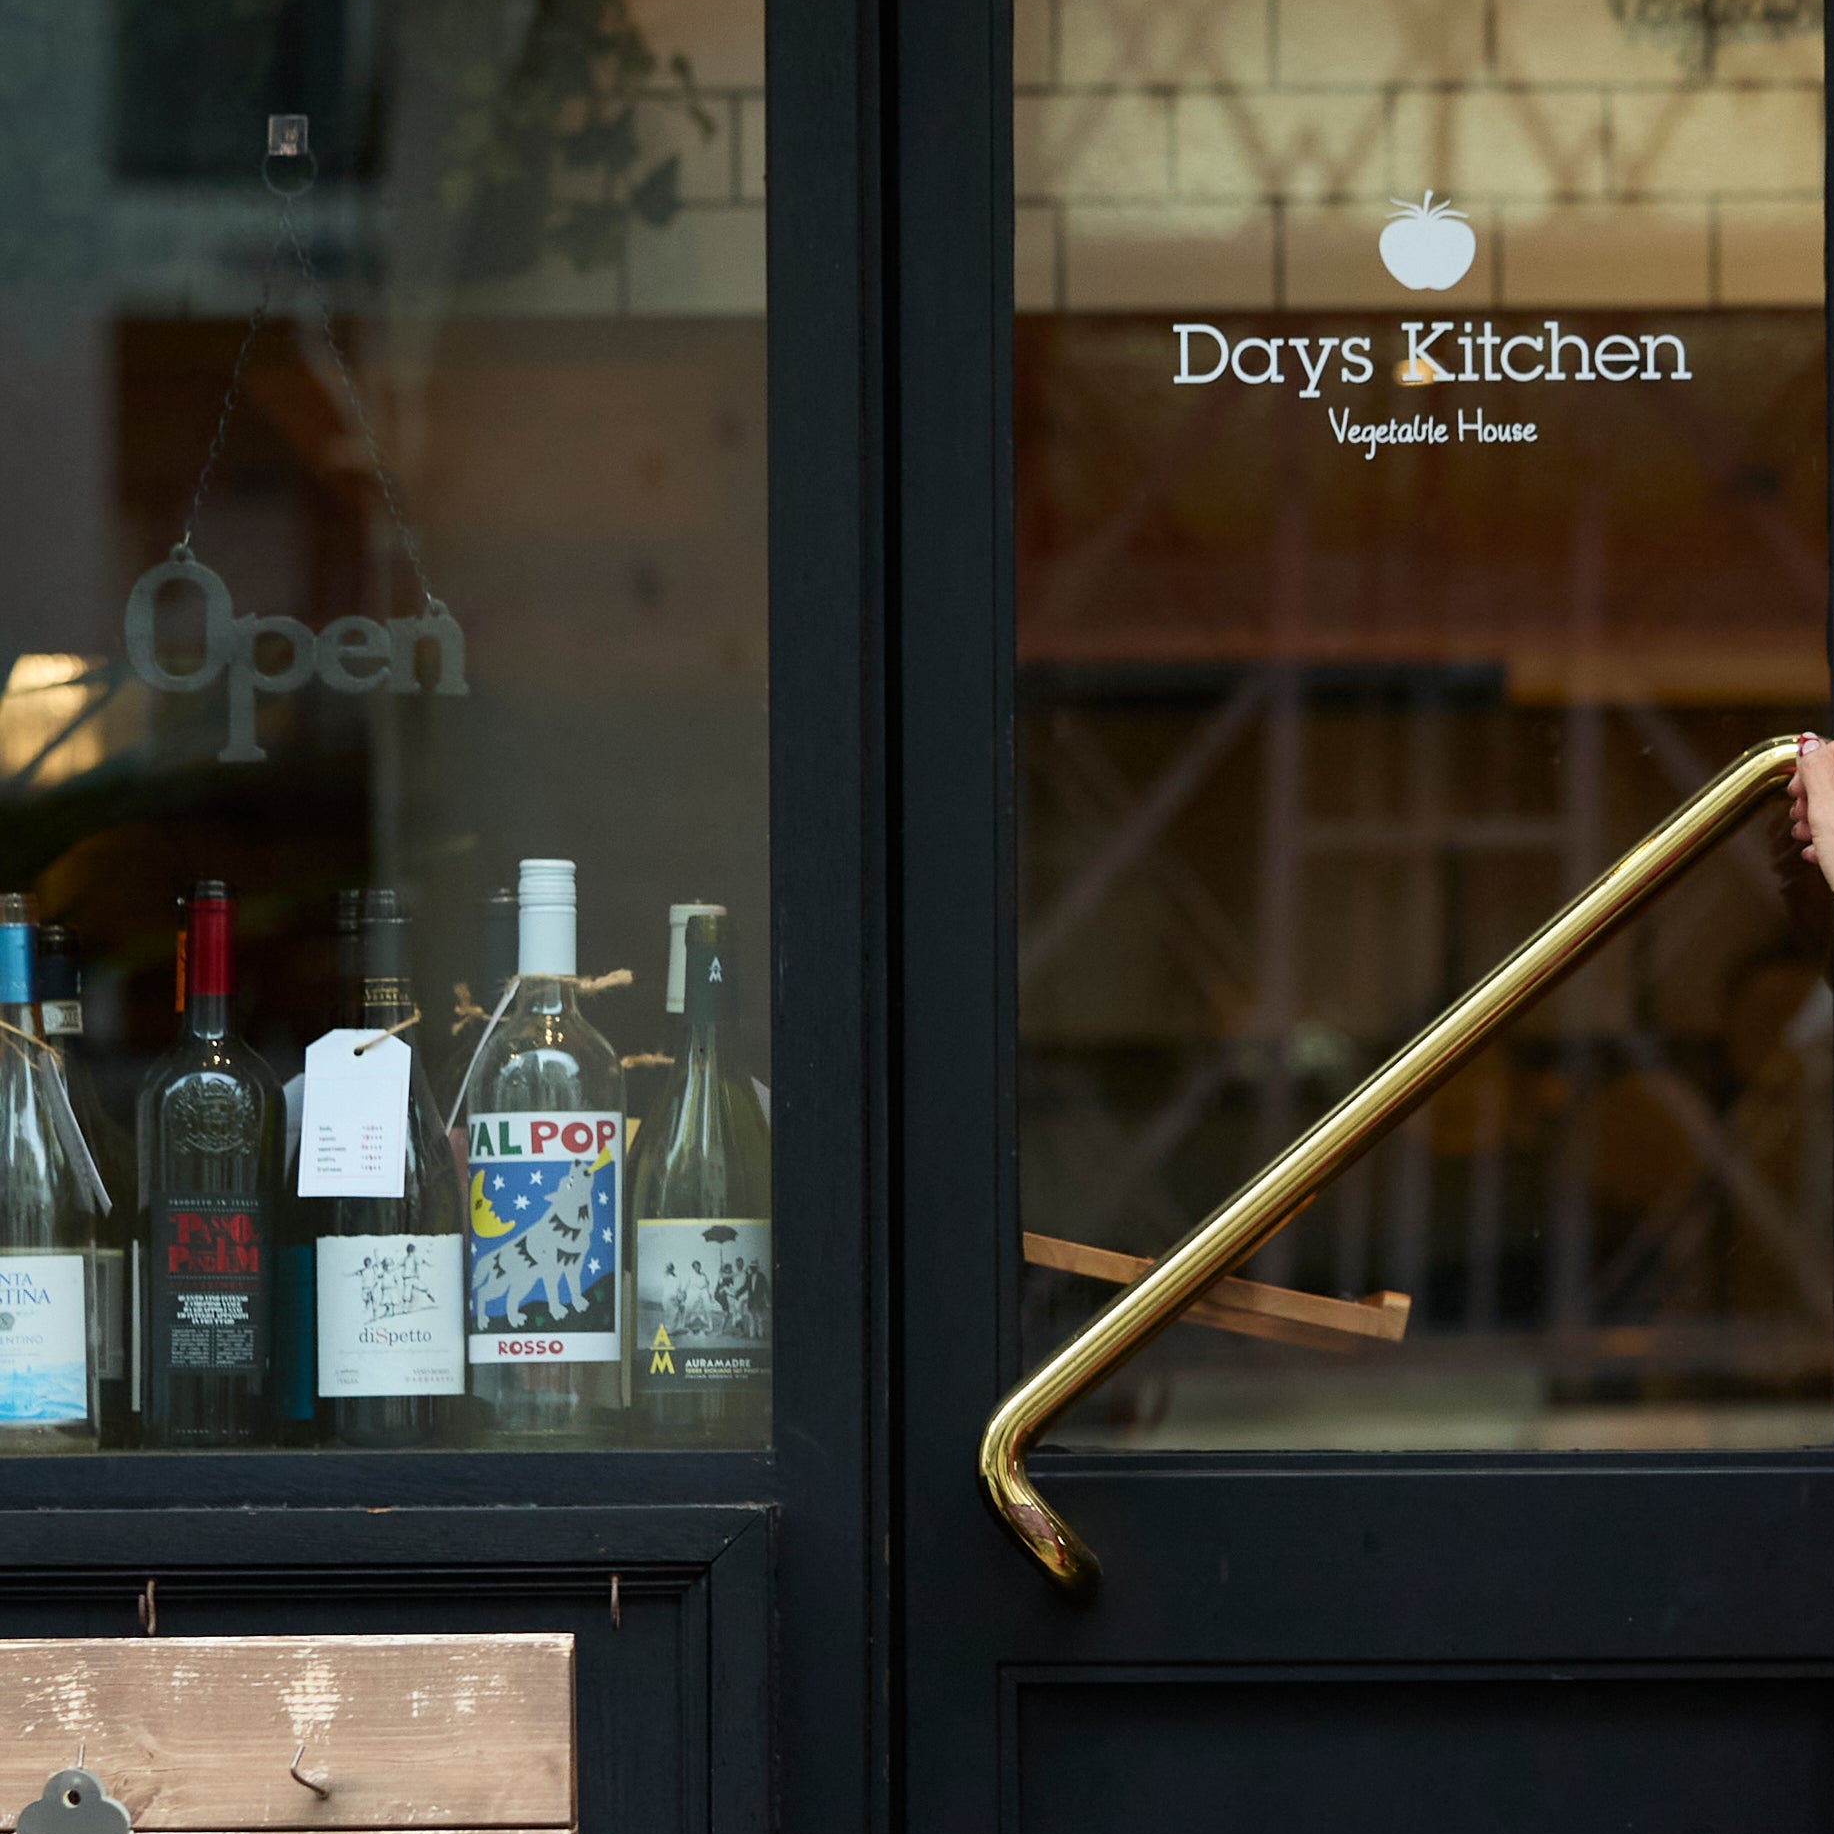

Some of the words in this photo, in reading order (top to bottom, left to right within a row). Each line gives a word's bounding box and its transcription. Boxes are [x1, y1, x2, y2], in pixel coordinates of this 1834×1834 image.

[1172, 322, 1374, 399] Days
[1400, 320, 1693, 383] Kitchen
[1327, 406, 1449, 461] Vegetable
[1457, 407, 1538, 445] House
[124, 559, 470, 763] Open
[529, 1119, 617, 1155] POP
[358, 1326, 433, 1347] diSpetto
[497, 1339, 565, 1356] ROSSO
[684, 1358, 752, 1368] AURAMADRE
